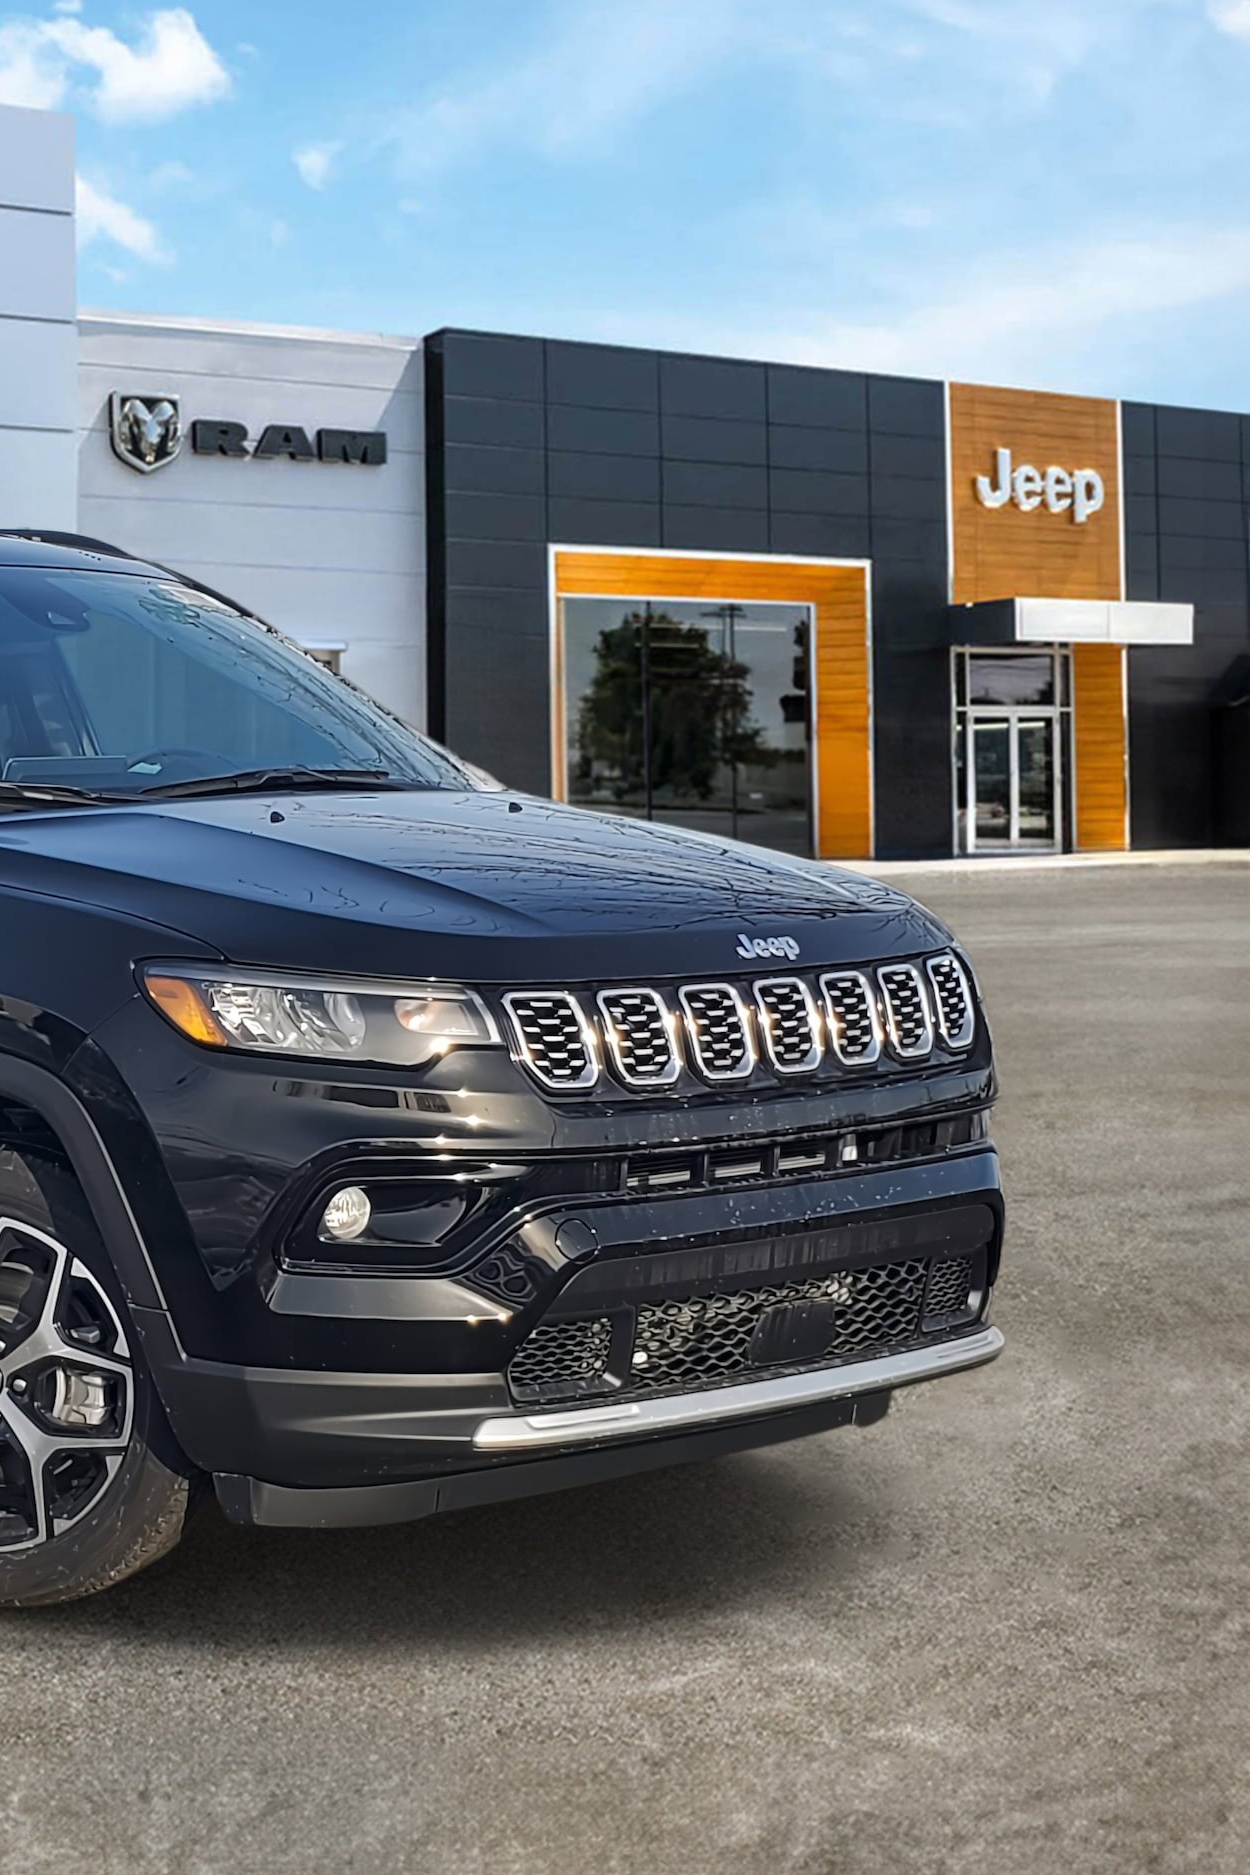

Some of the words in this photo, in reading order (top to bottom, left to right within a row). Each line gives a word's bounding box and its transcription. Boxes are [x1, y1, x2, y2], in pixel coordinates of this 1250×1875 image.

[191, 419, 387, 465] RAM
[975, 446, 1104, 524] Jeep
[735, 933, 800, 961] Jeep
